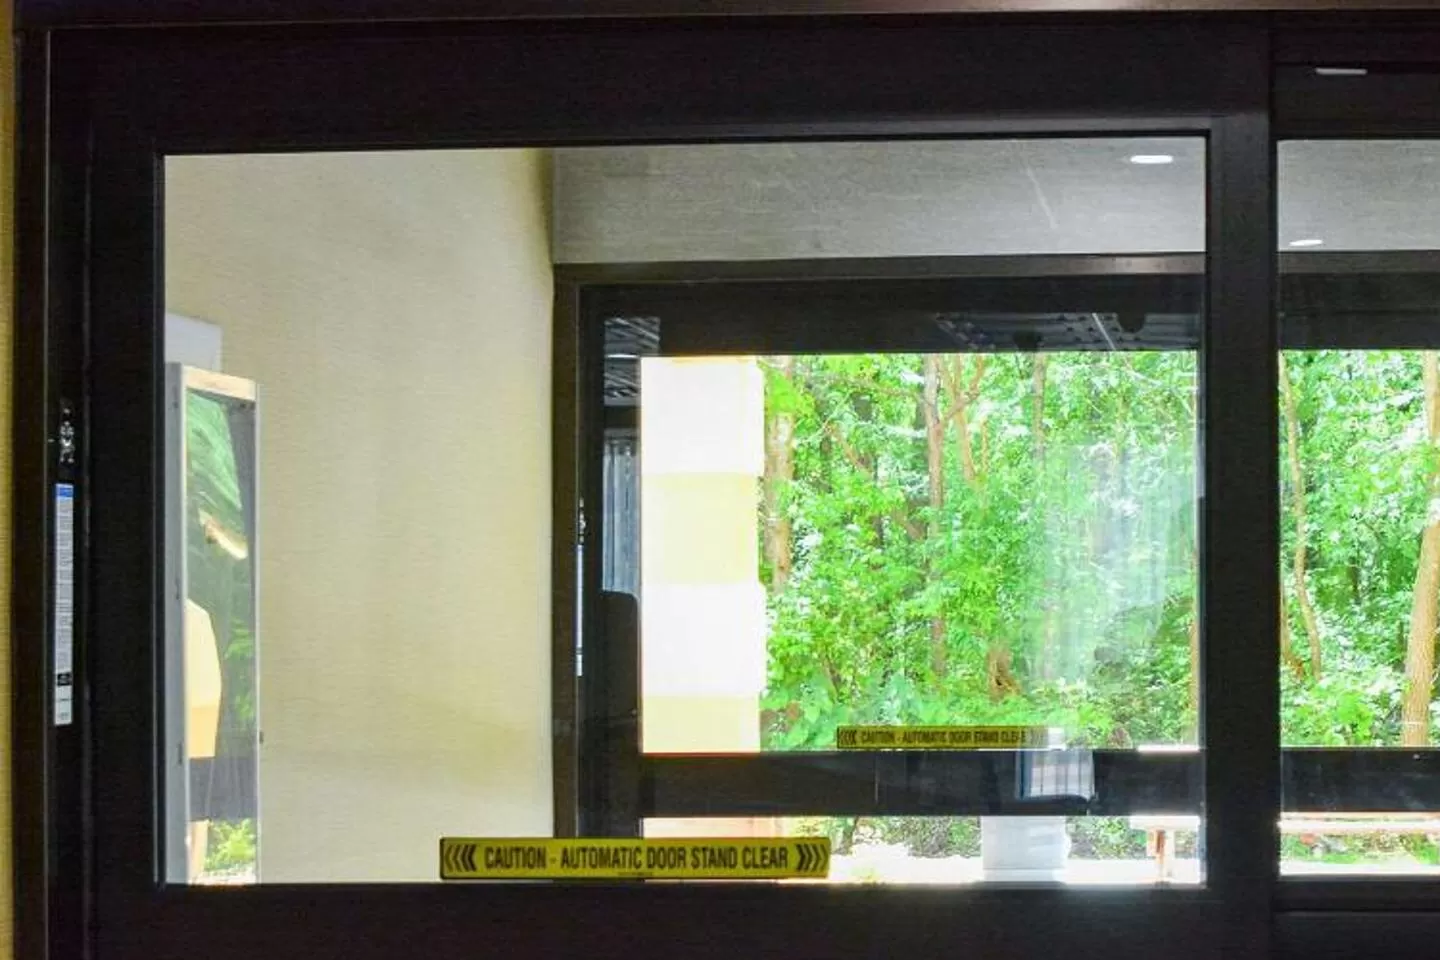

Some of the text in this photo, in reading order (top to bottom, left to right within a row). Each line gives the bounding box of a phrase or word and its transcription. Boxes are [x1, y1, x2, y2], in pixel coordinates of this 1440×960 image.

[485, 845, 547, 870] CAUTION
[560, 845, 643, 870] AUTOMATIC
[647, 845, 687, 870] DOOR
[690, 845, 738, 870] STAND
[742, 845, 789, 869] CLEAR
